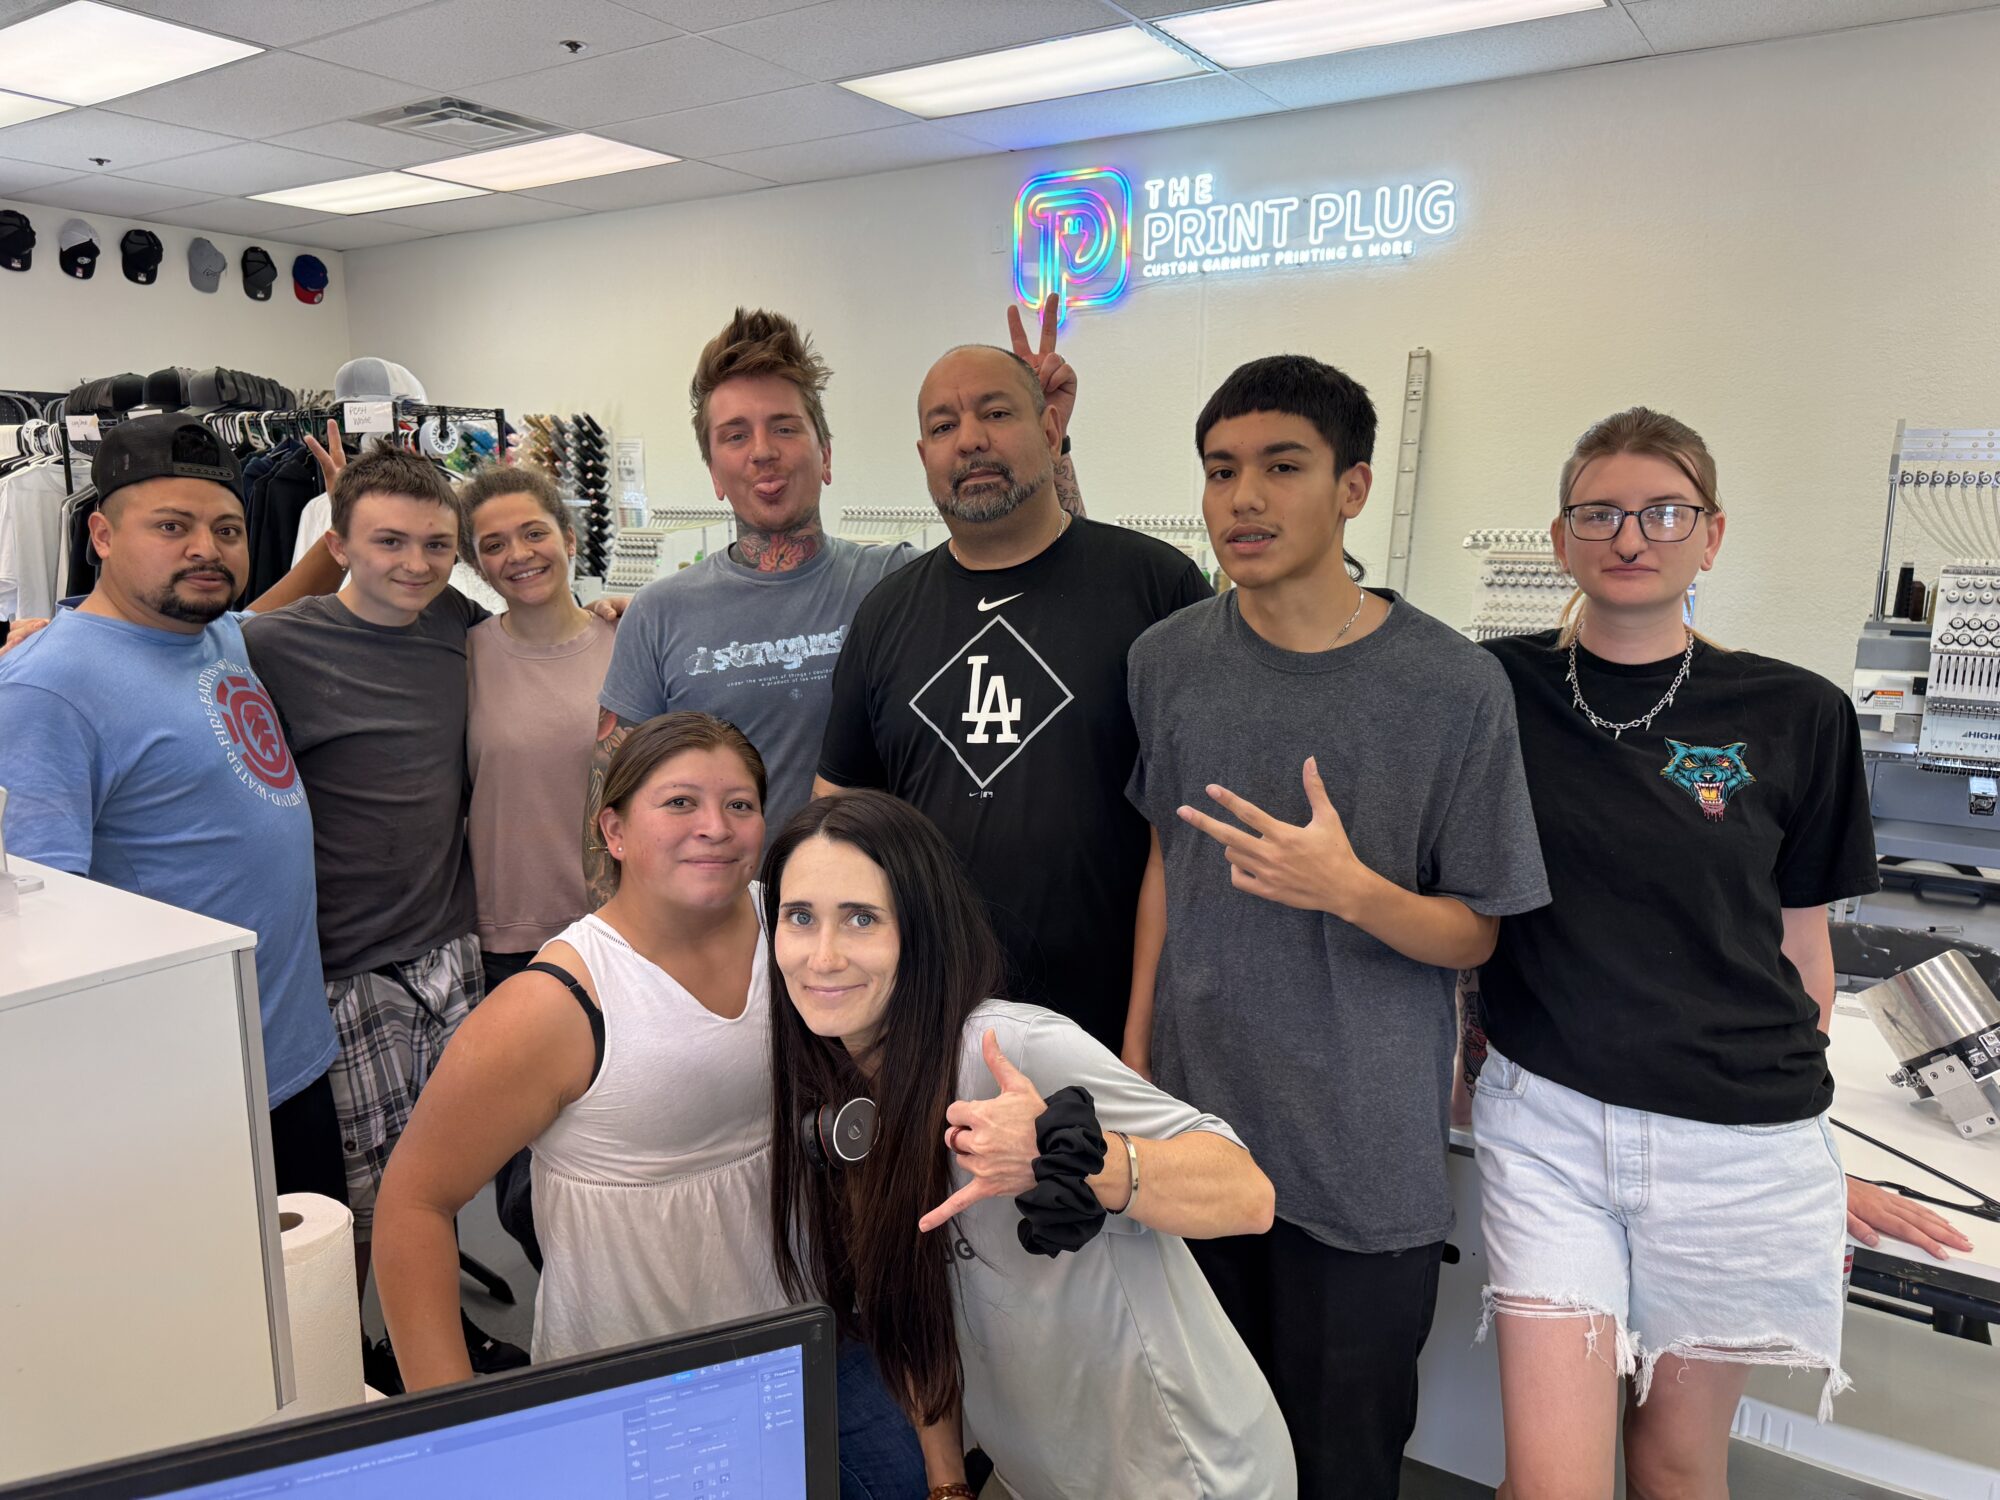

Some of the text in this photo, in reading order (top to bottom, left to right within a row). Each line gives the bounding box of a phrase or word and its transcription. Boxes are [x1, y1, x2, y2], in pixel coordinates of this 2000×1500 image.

[1144, 173, 1213, 210] THE
[1142, 179, 1456, 261] PRINT PLUG
[1142, 240, 1413, 277] CUSTOM GARMENT PRINTING & MORE
[198, 667, 219, 706] EARTH
[961, 655, 1022, 744] LA
[206, 707, 230, 747] FIRE
[226, 751, 267, 801] WATER
